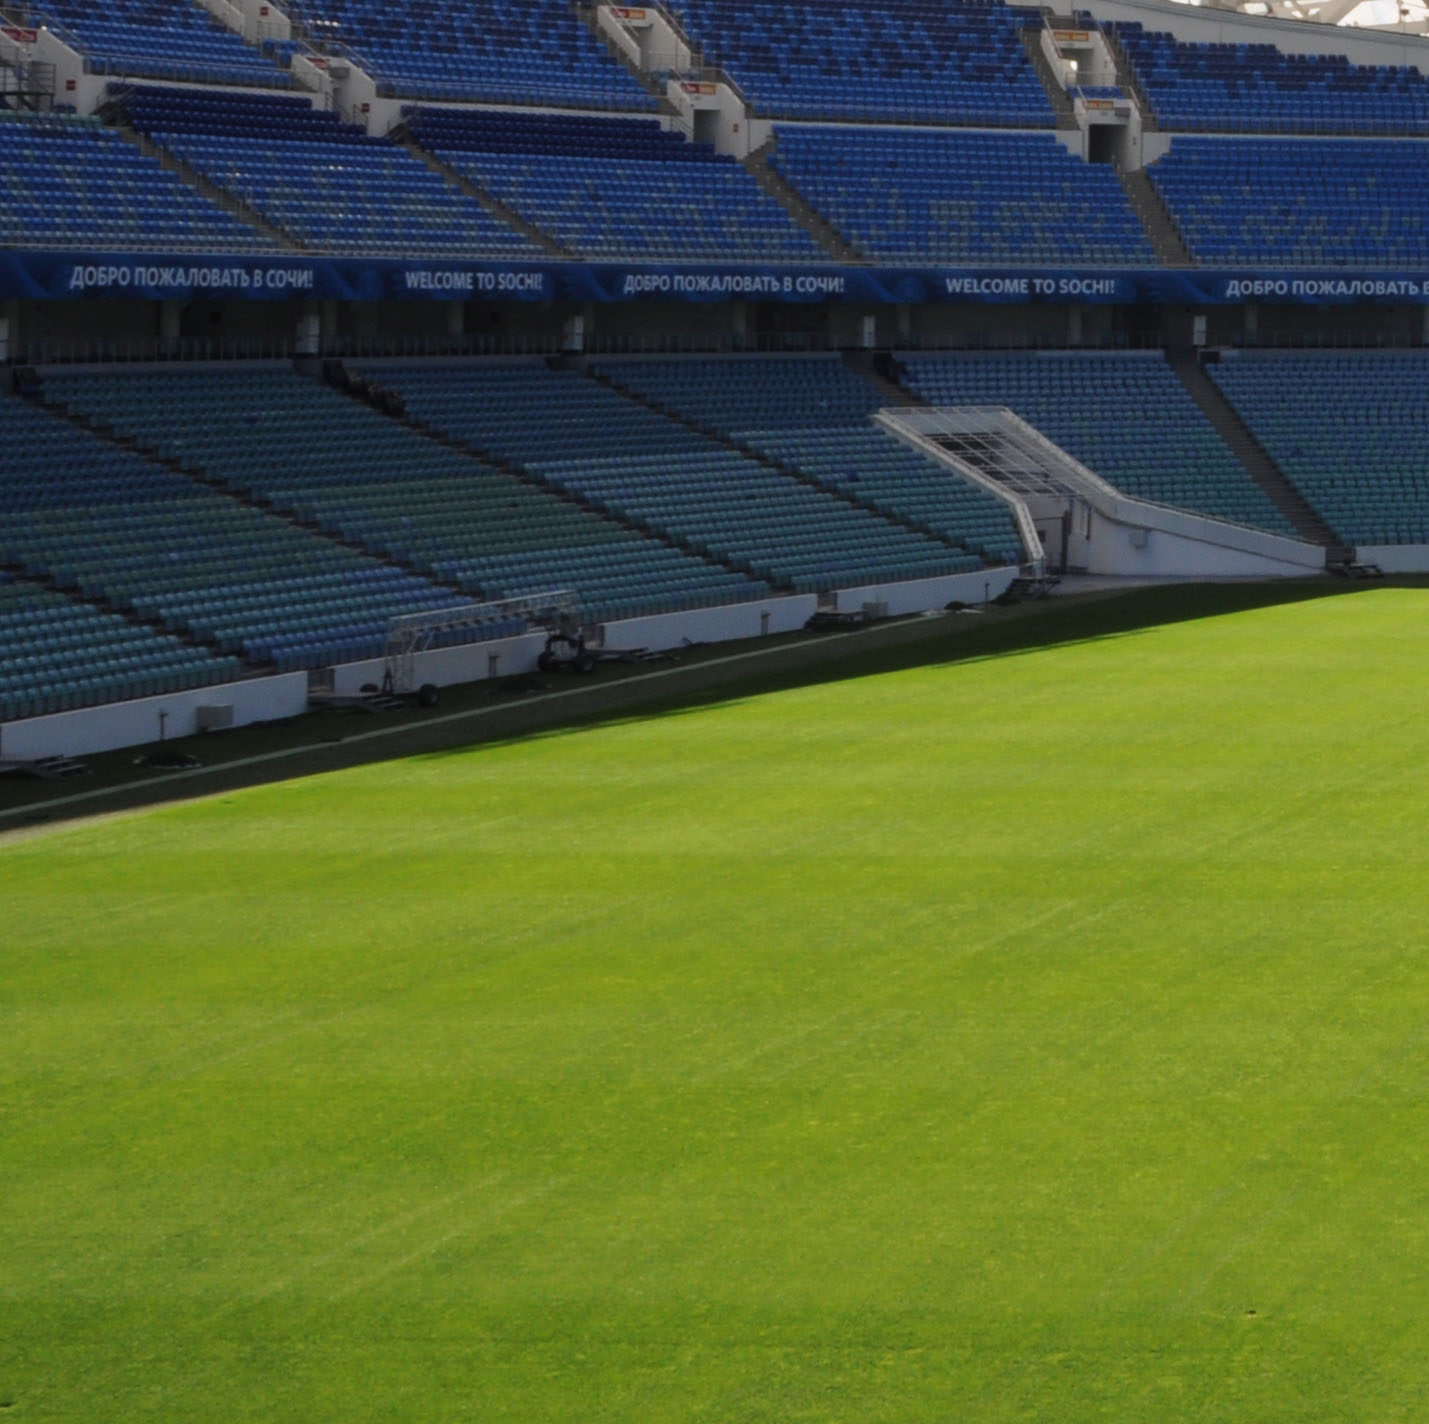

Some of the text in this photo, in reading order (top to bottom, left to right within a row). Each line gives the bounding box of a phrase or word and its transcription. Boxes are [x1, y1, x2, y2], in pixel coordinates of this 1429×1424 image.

[69, 265, 313, 289] ДОБРО ПОЖАЛОВАТЬ В СОЧИ!
[405, 271, 543, 291] WELCOME TO SOCHI!
[623, 274, 845, 294] ДОБРО ПОЖАЛОВАТЬ В СОЧИ!
[945, 277, 1115, 294] WELCOME TO SOCHI!
[1226, 279, 1288, 297] ДОБРО
[1292, 280, 1419, 295] ПОЖАЛОВАТЬ
